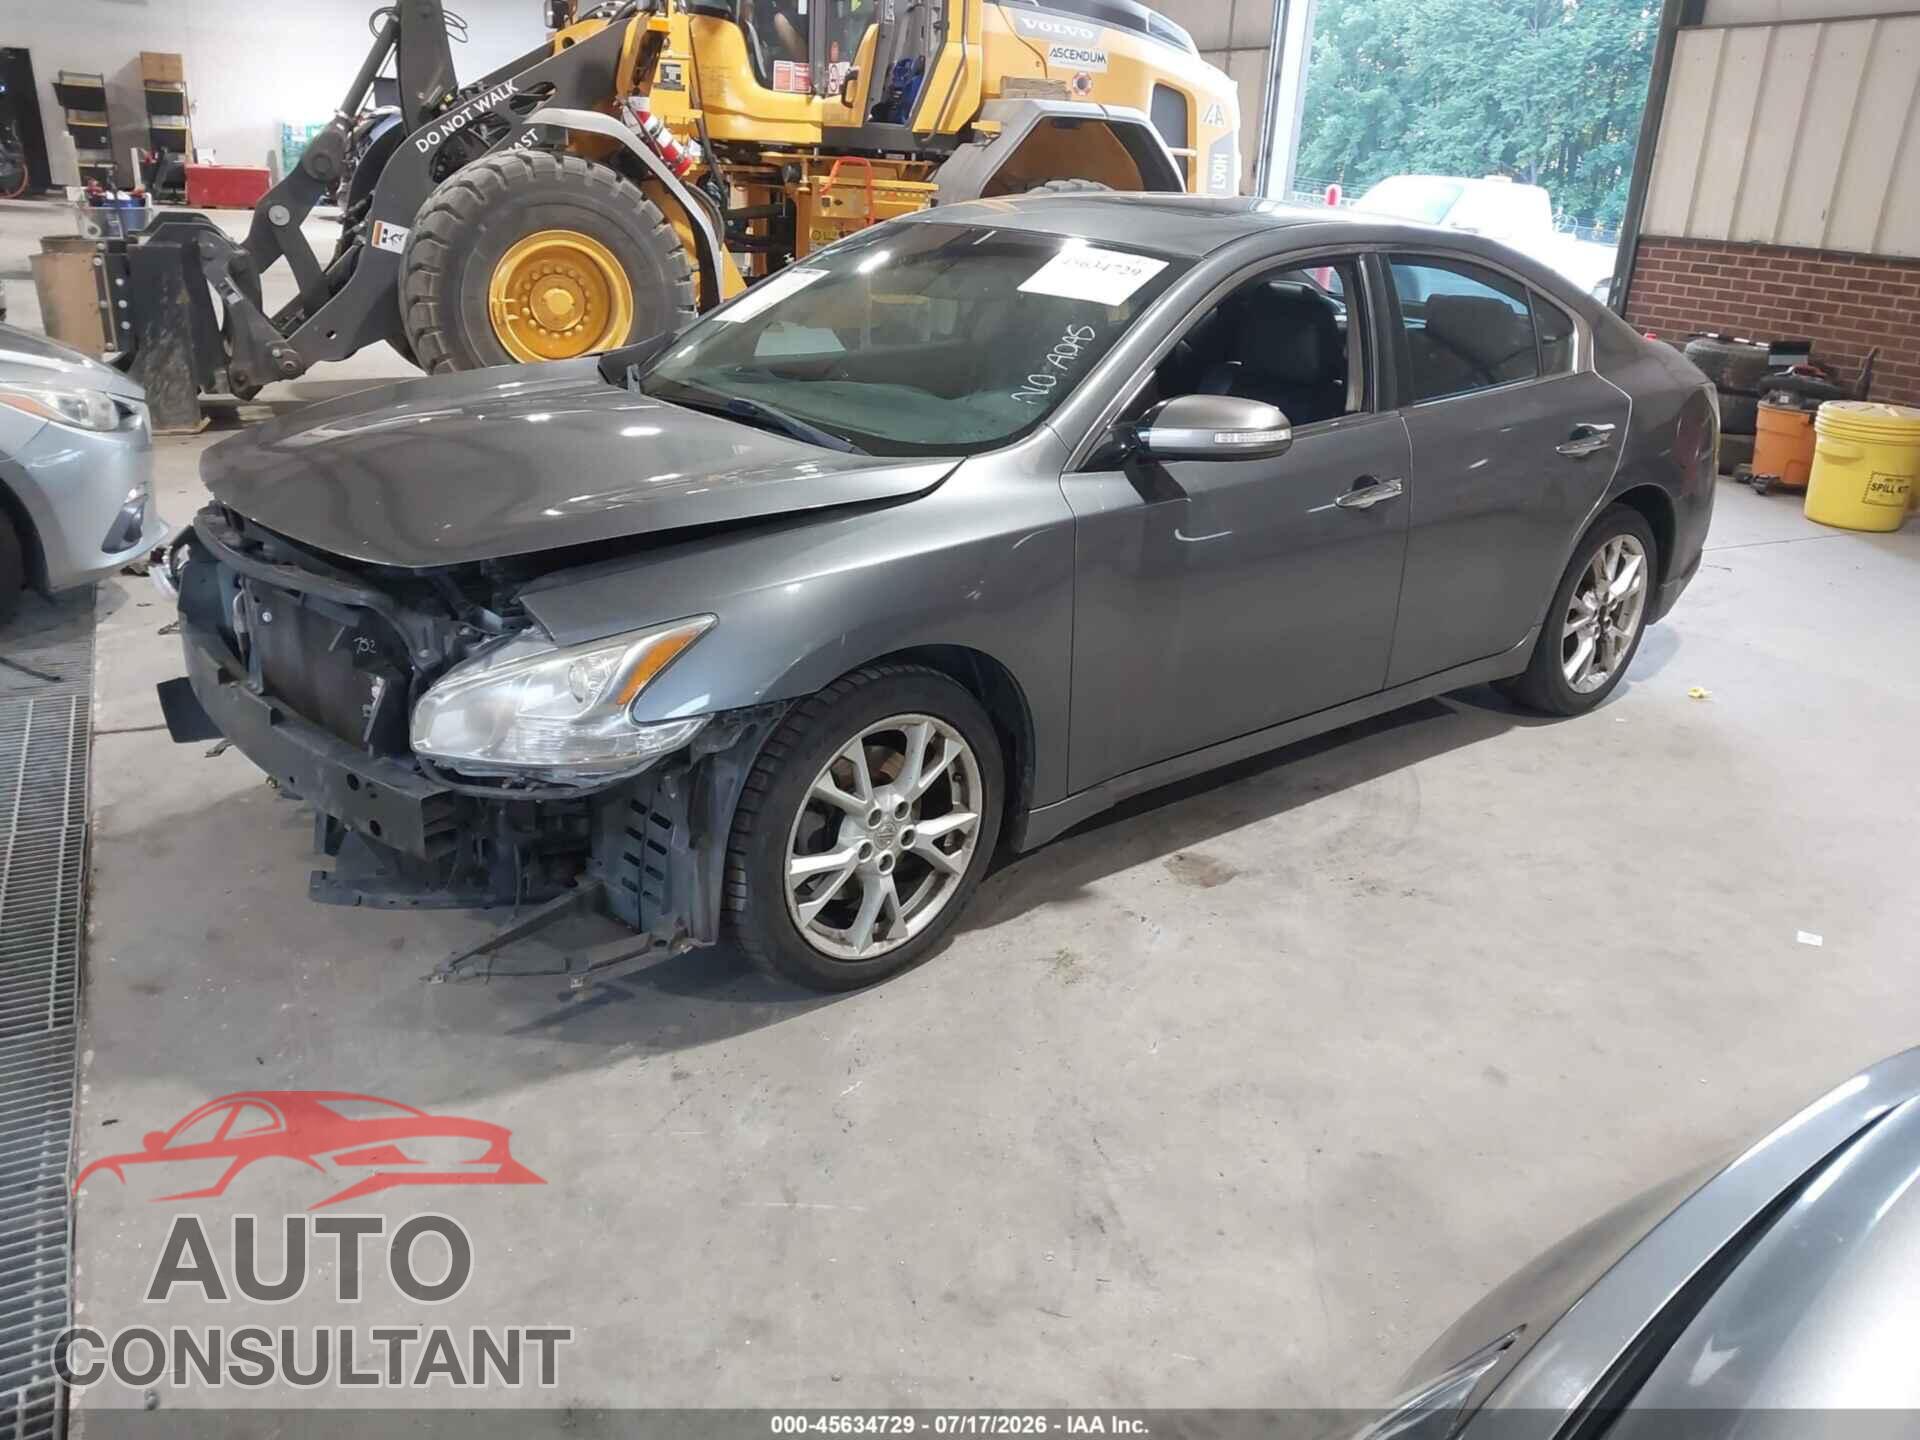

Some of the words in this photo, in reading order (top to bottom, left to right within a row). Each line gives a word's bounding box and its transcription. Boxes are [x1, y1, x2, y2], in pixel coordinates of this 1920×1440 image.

[1021, 18, 1095, 39] VOLVO
[1049, 47, 1107, 64] ASCENDUM
[415, 131, 441, 153] DO
[440, 107, 473, 137] NOT
[473, 79, 519, 113] WALK
[508, 128, 539, 152] AST
[1010, 374, 1057, 402] NO
[1871, 482, 1895, 495] SPILL
